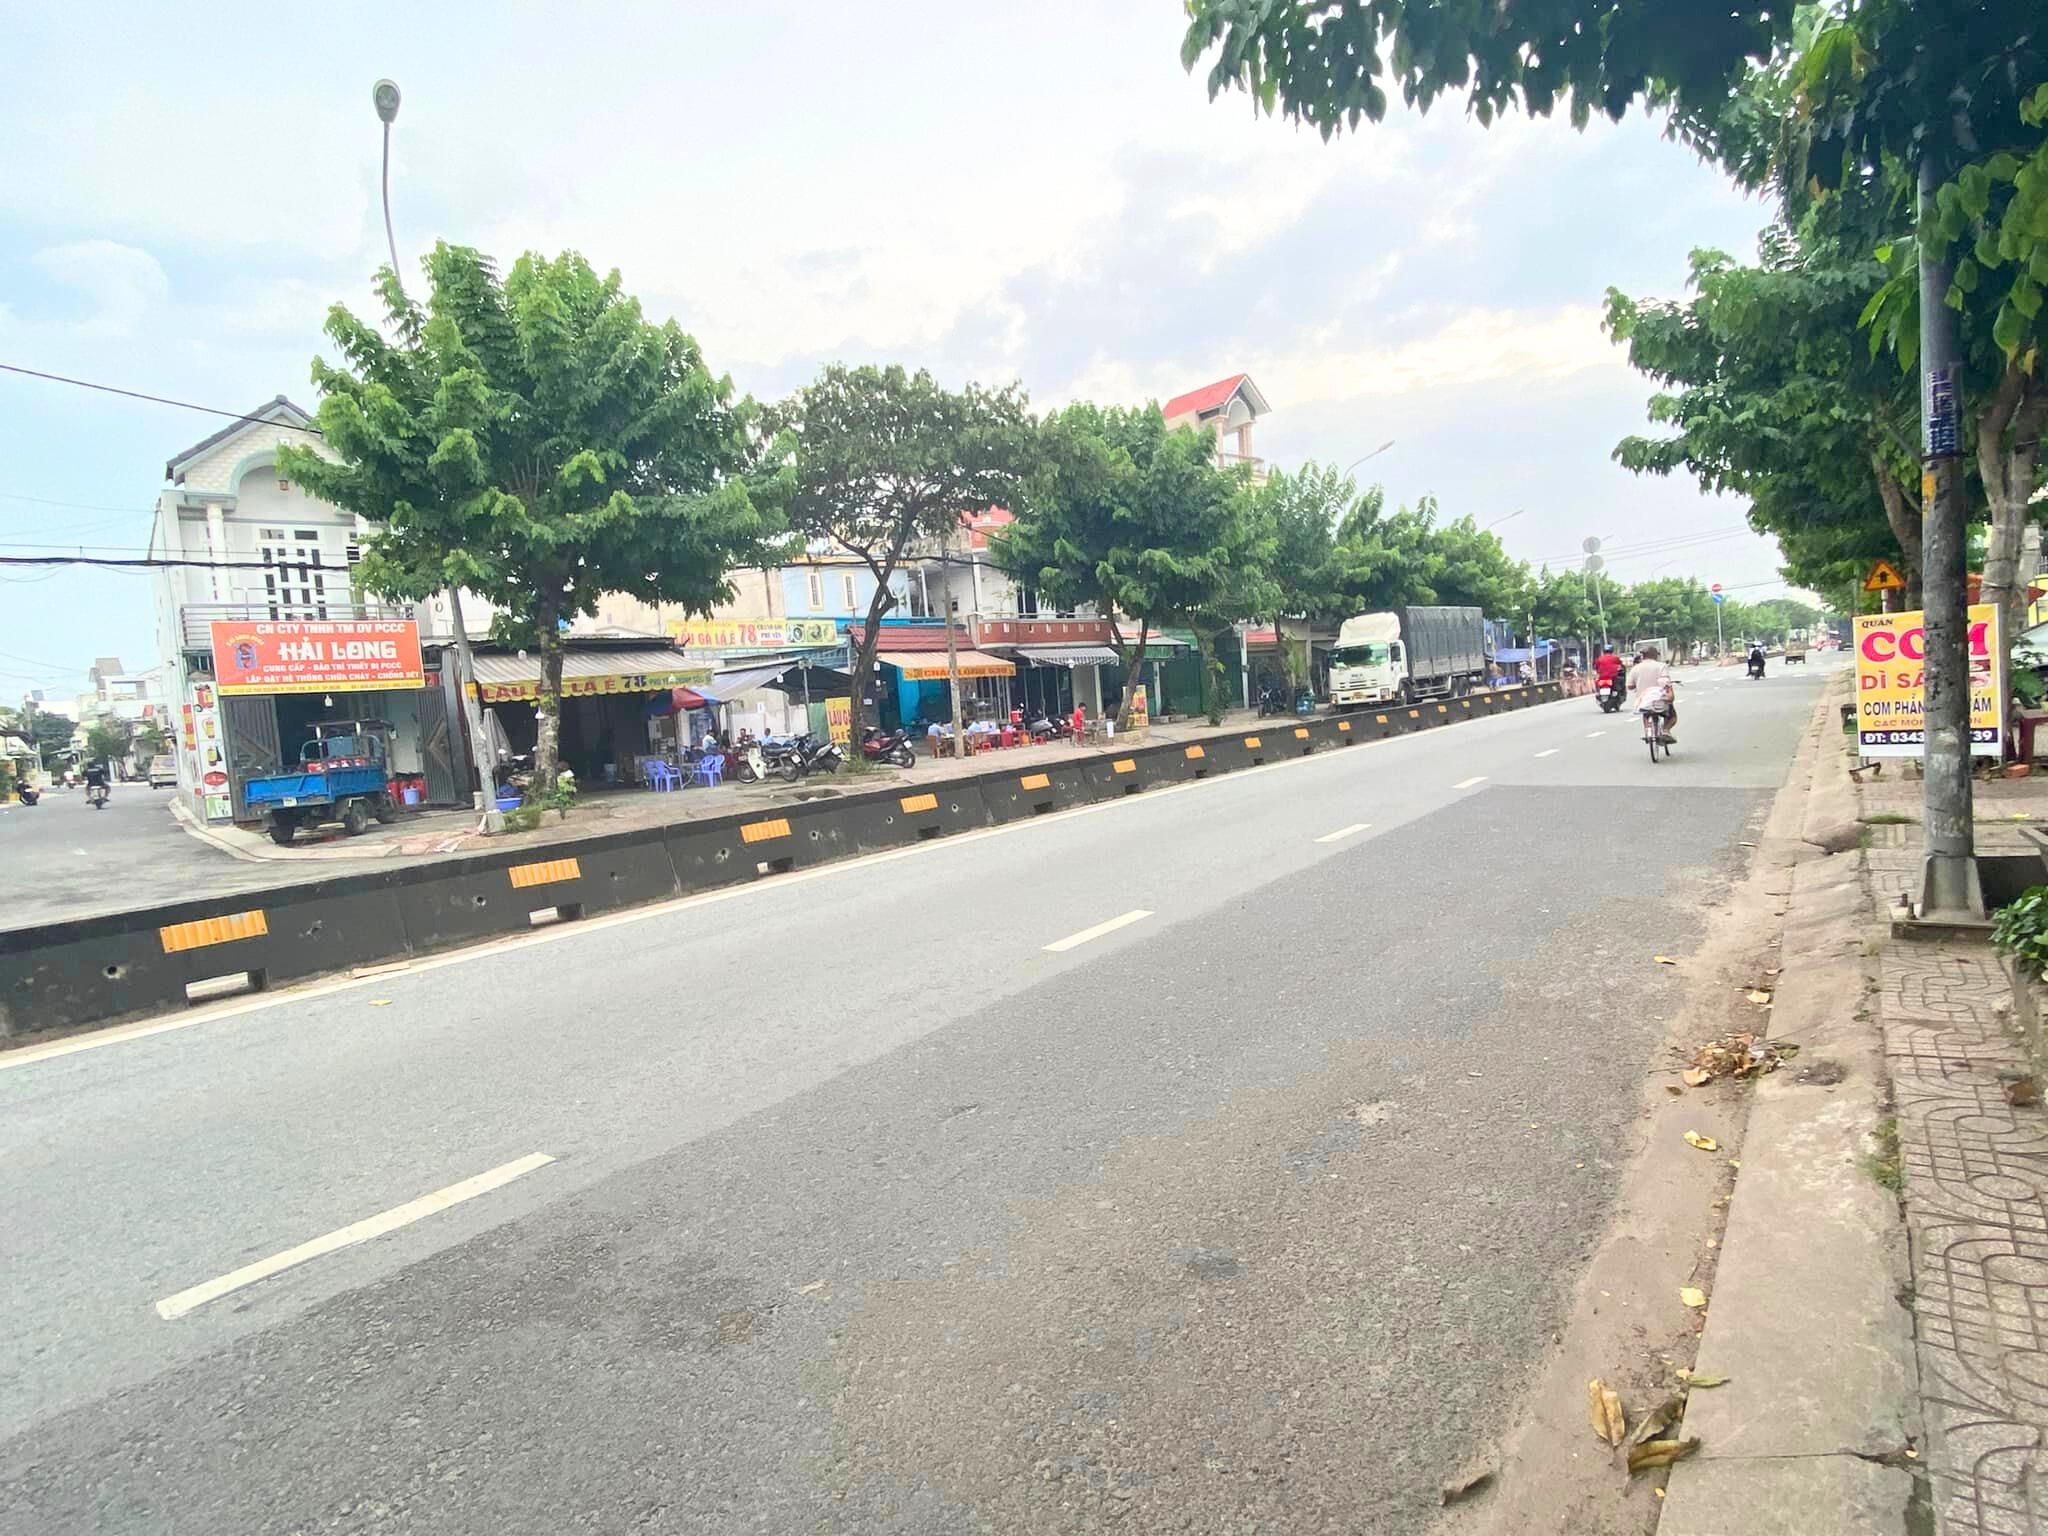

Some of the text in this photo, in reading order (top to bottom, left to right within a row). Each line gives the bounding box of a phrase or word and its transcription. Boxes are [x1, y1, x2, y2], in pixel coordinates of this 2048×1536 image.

[256, 623, 405, 634] CN CTY TNHH TM DV PCCC
[1861, 618, 1894, 629] QUÁN
[738, 624, 757, 646] 78
[278, 636, 324, 661] HẢI
[331, 640, 398, 660] LONG
[263, 664, 286, 672] CUNG
[288, 663, 305, 672] CẤP
[621, 674, 647, 688] 78
[1861, 670, 1887, 690] DÌ
[1863, 700, 1891, 716] CƠM
[1864, 732, 1888, 744] ĐT:
[1969, 730, 1993, 742] 39
